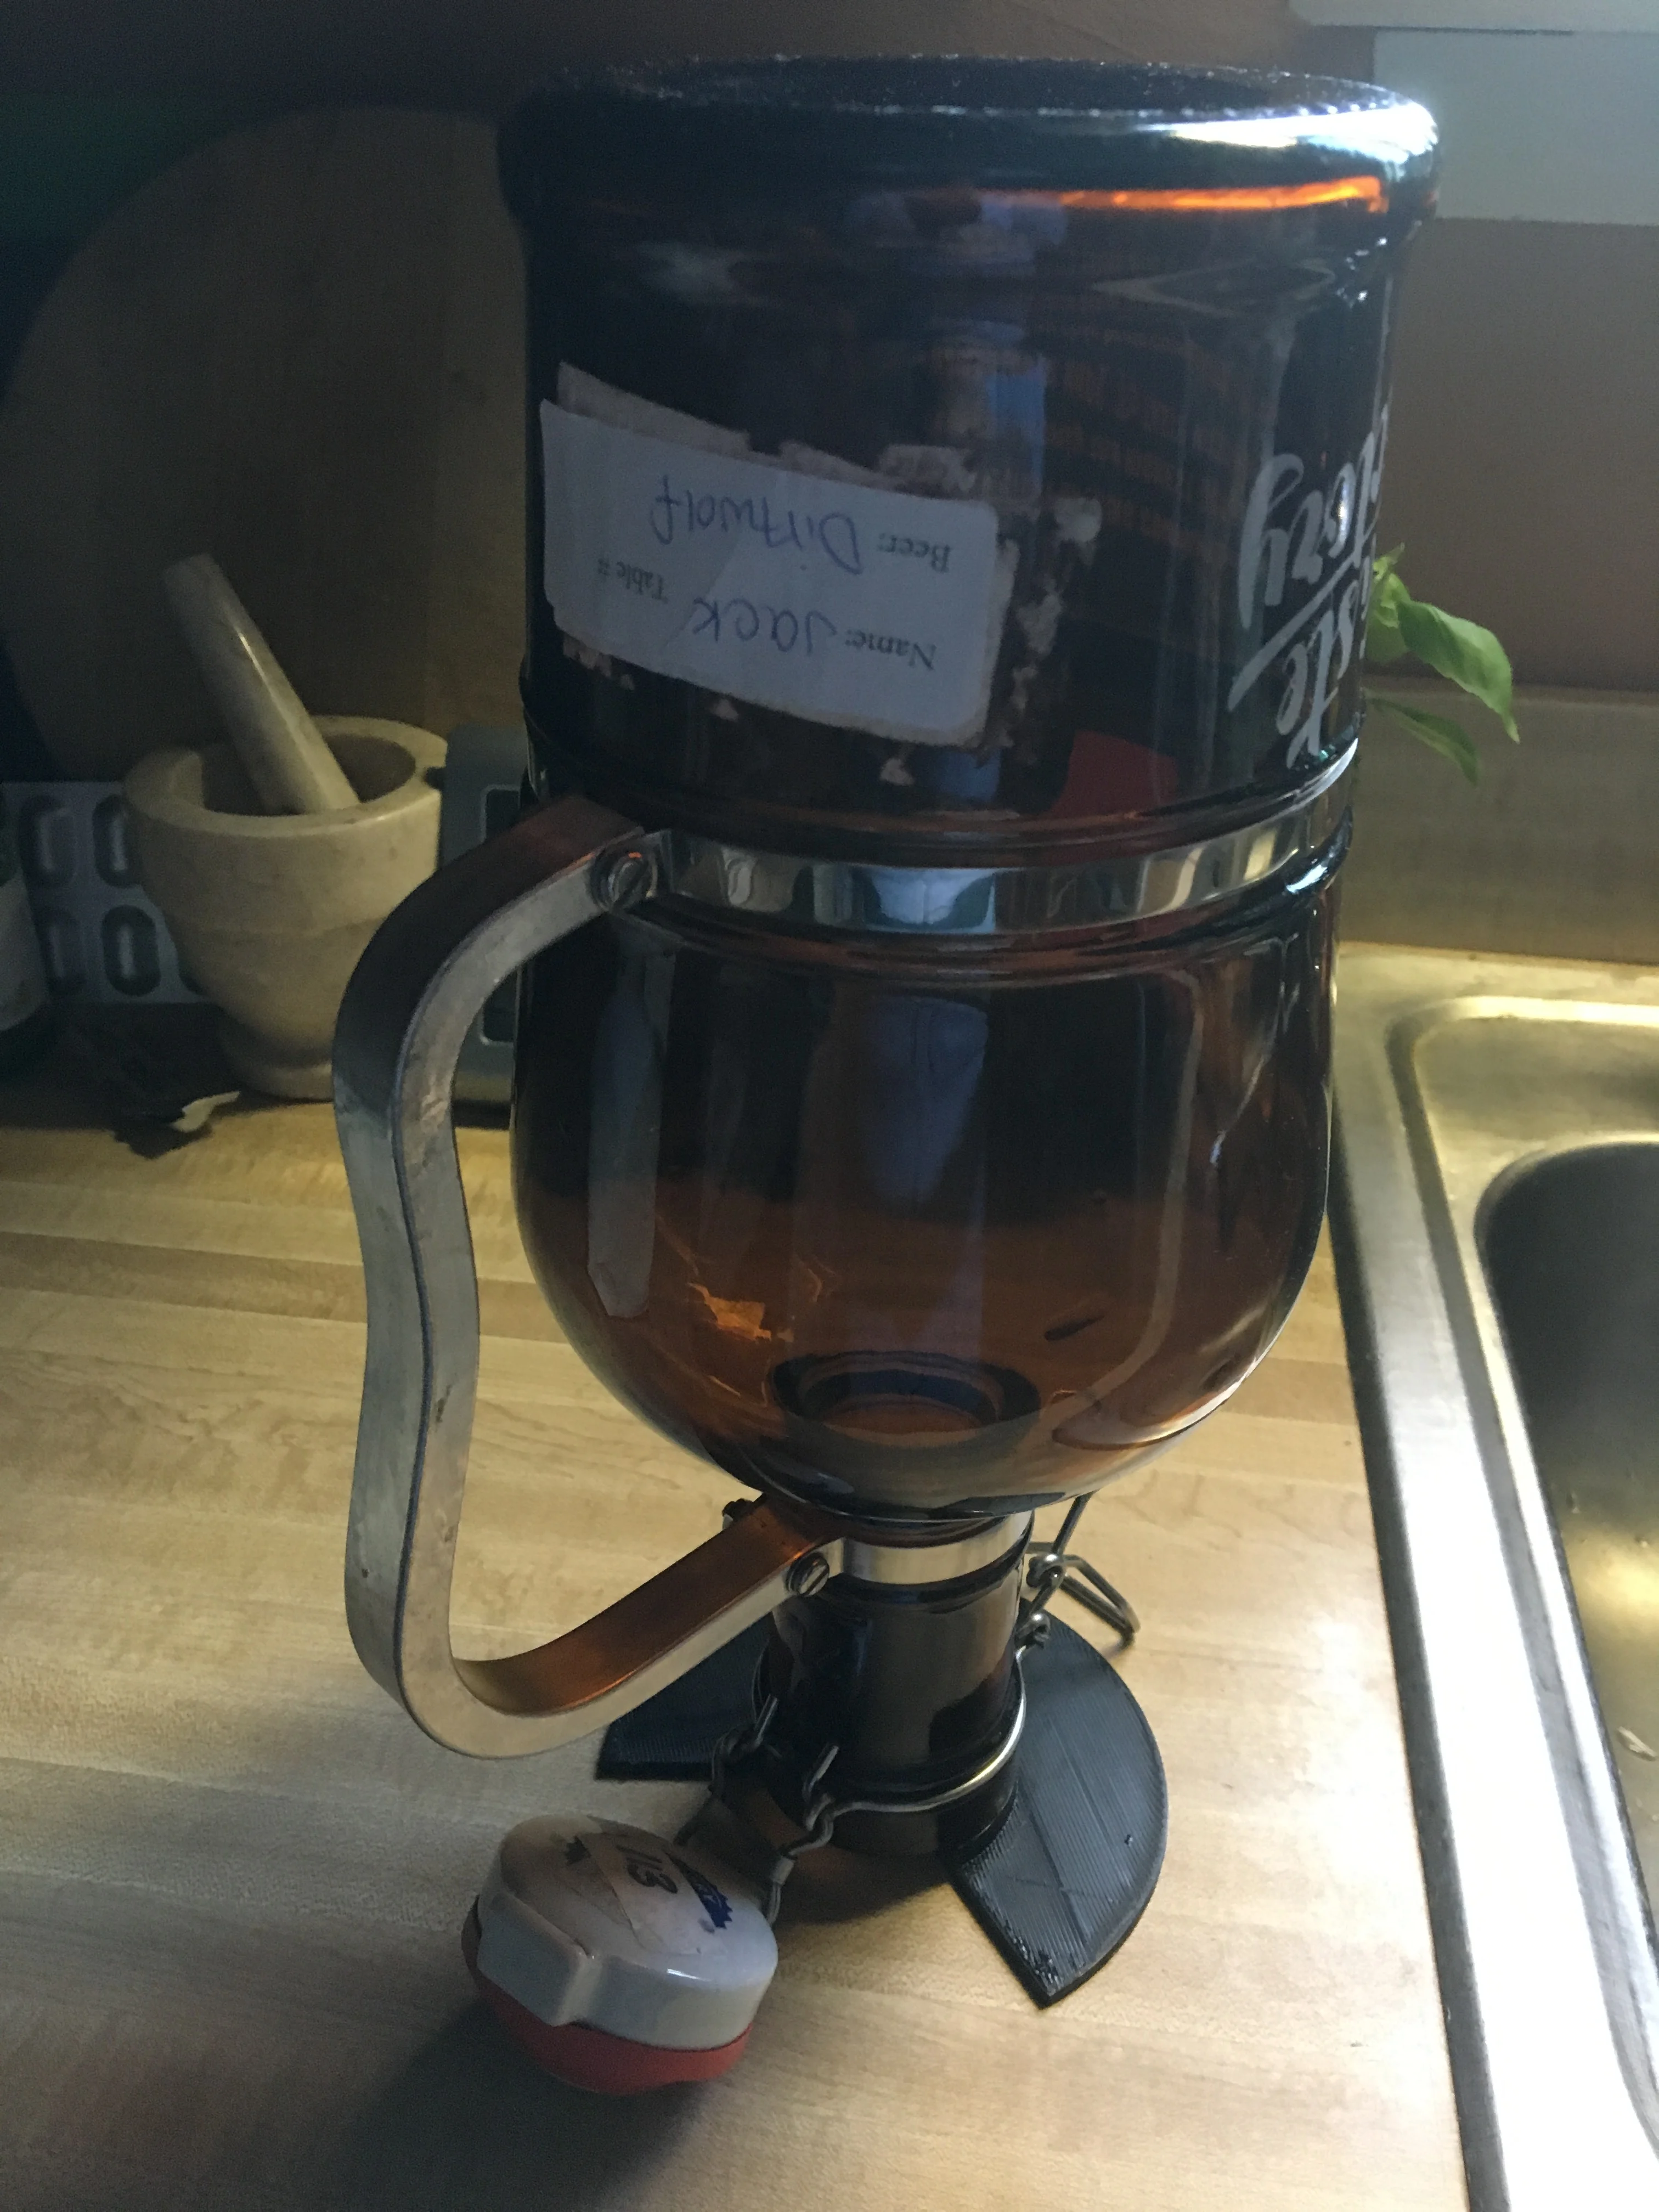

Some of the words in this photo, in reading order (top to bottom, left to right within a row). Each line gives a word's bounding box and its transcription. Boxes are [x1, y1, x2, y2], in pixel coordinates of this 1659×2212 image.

[878, 532, 951, 573] Beer:
[616, 561, 668, 603] Table
[844, 629, 936, 670] Name:
